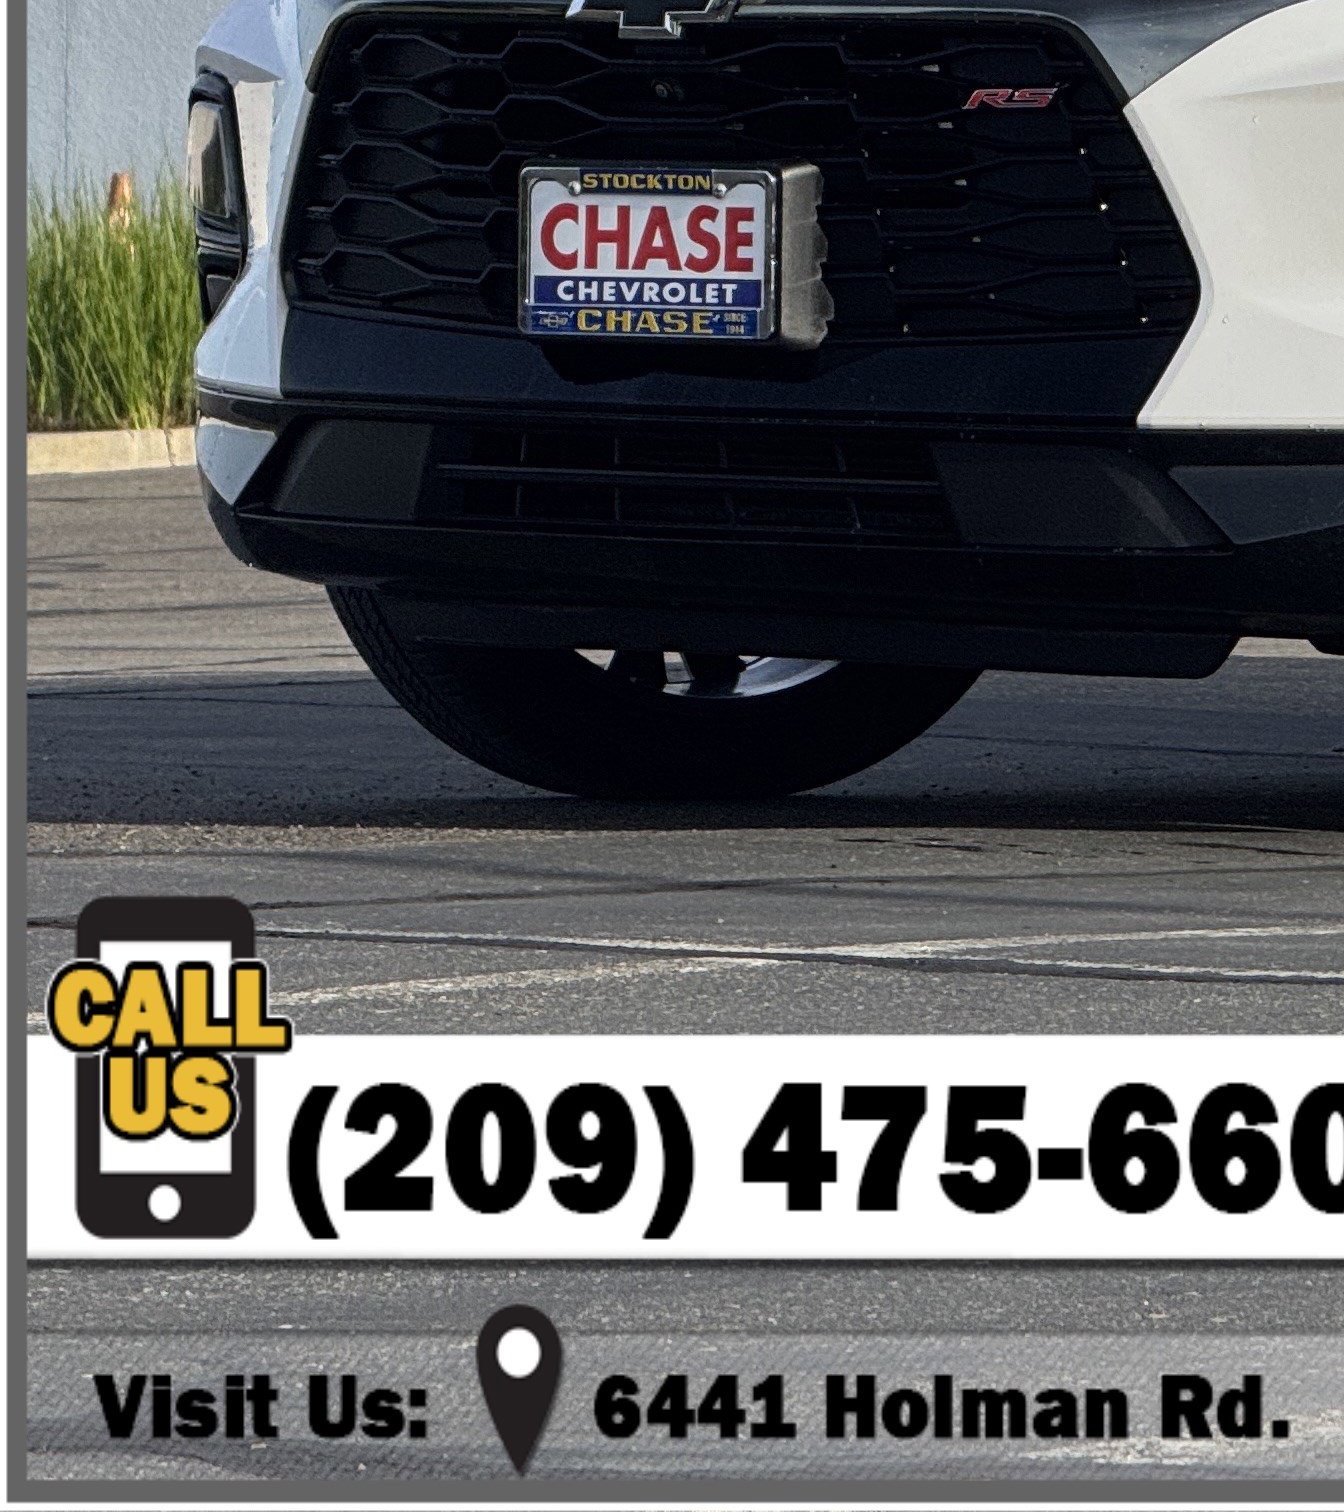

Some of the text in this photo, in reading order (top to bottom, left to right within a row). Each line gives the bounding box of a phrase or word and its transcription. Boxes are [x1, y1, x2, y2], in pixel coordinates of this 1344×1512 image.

[962, 88, 1058, 109] RS
[582, 173, 711, 190] STOCKTON
[540, 202, 755, 273] CHASE
[556, 280, 738, 304] CHEVROLET
[577, 309, 715, 335] CHASE
